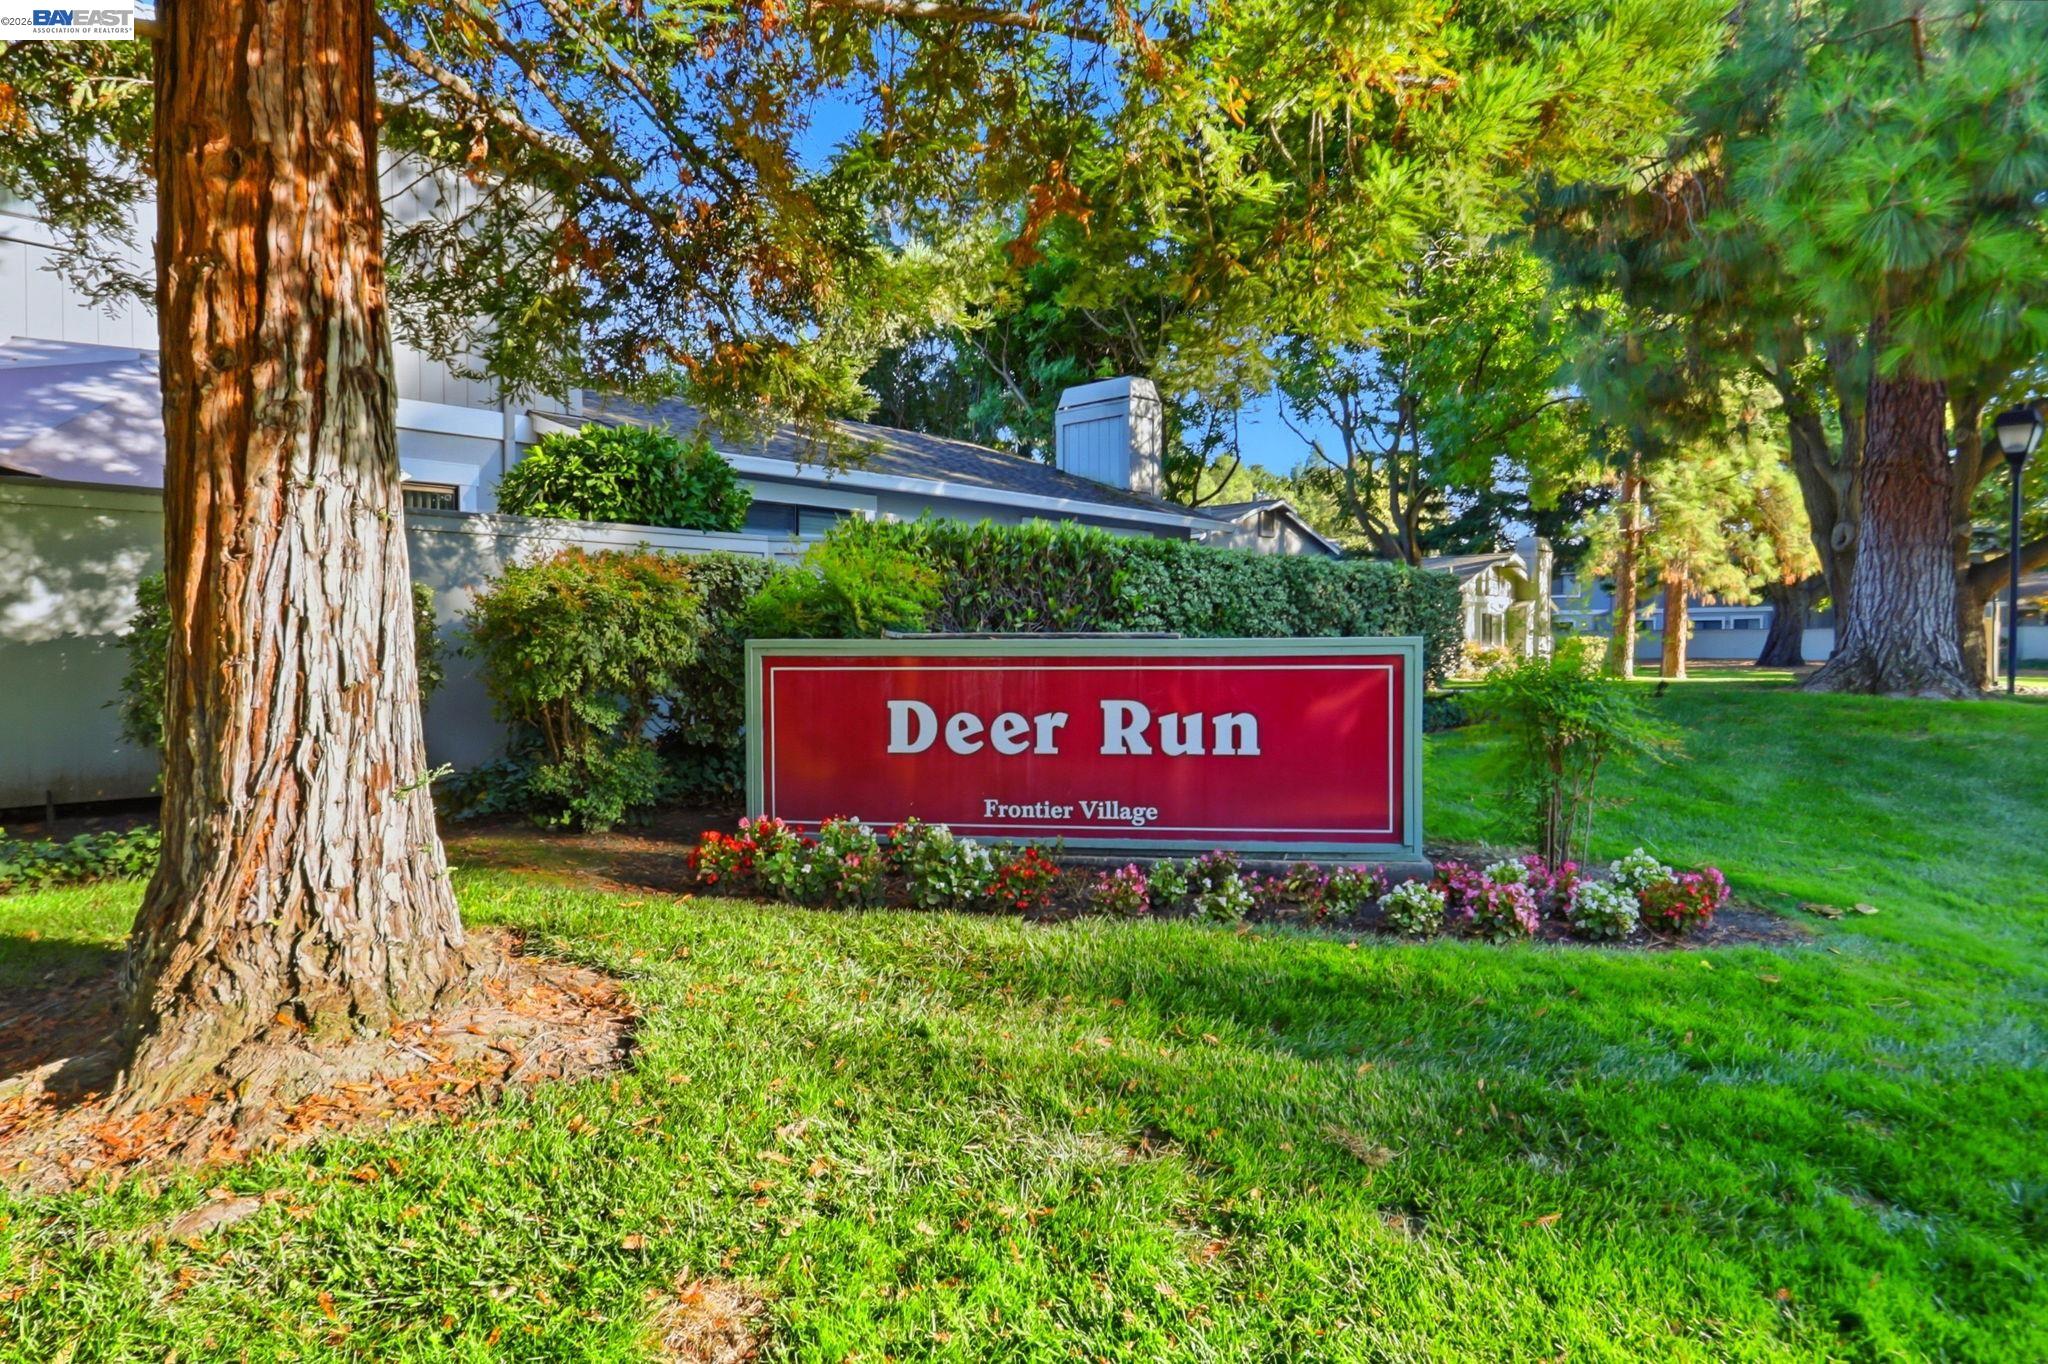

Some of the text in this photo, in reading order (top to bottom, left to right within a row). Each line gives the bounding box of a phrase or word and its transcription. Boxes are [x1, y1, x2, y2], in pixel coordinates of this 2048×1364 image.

[887, 700, 1261, 756] Deer Run
[984, 799, 1158, 827] Frontier Village
